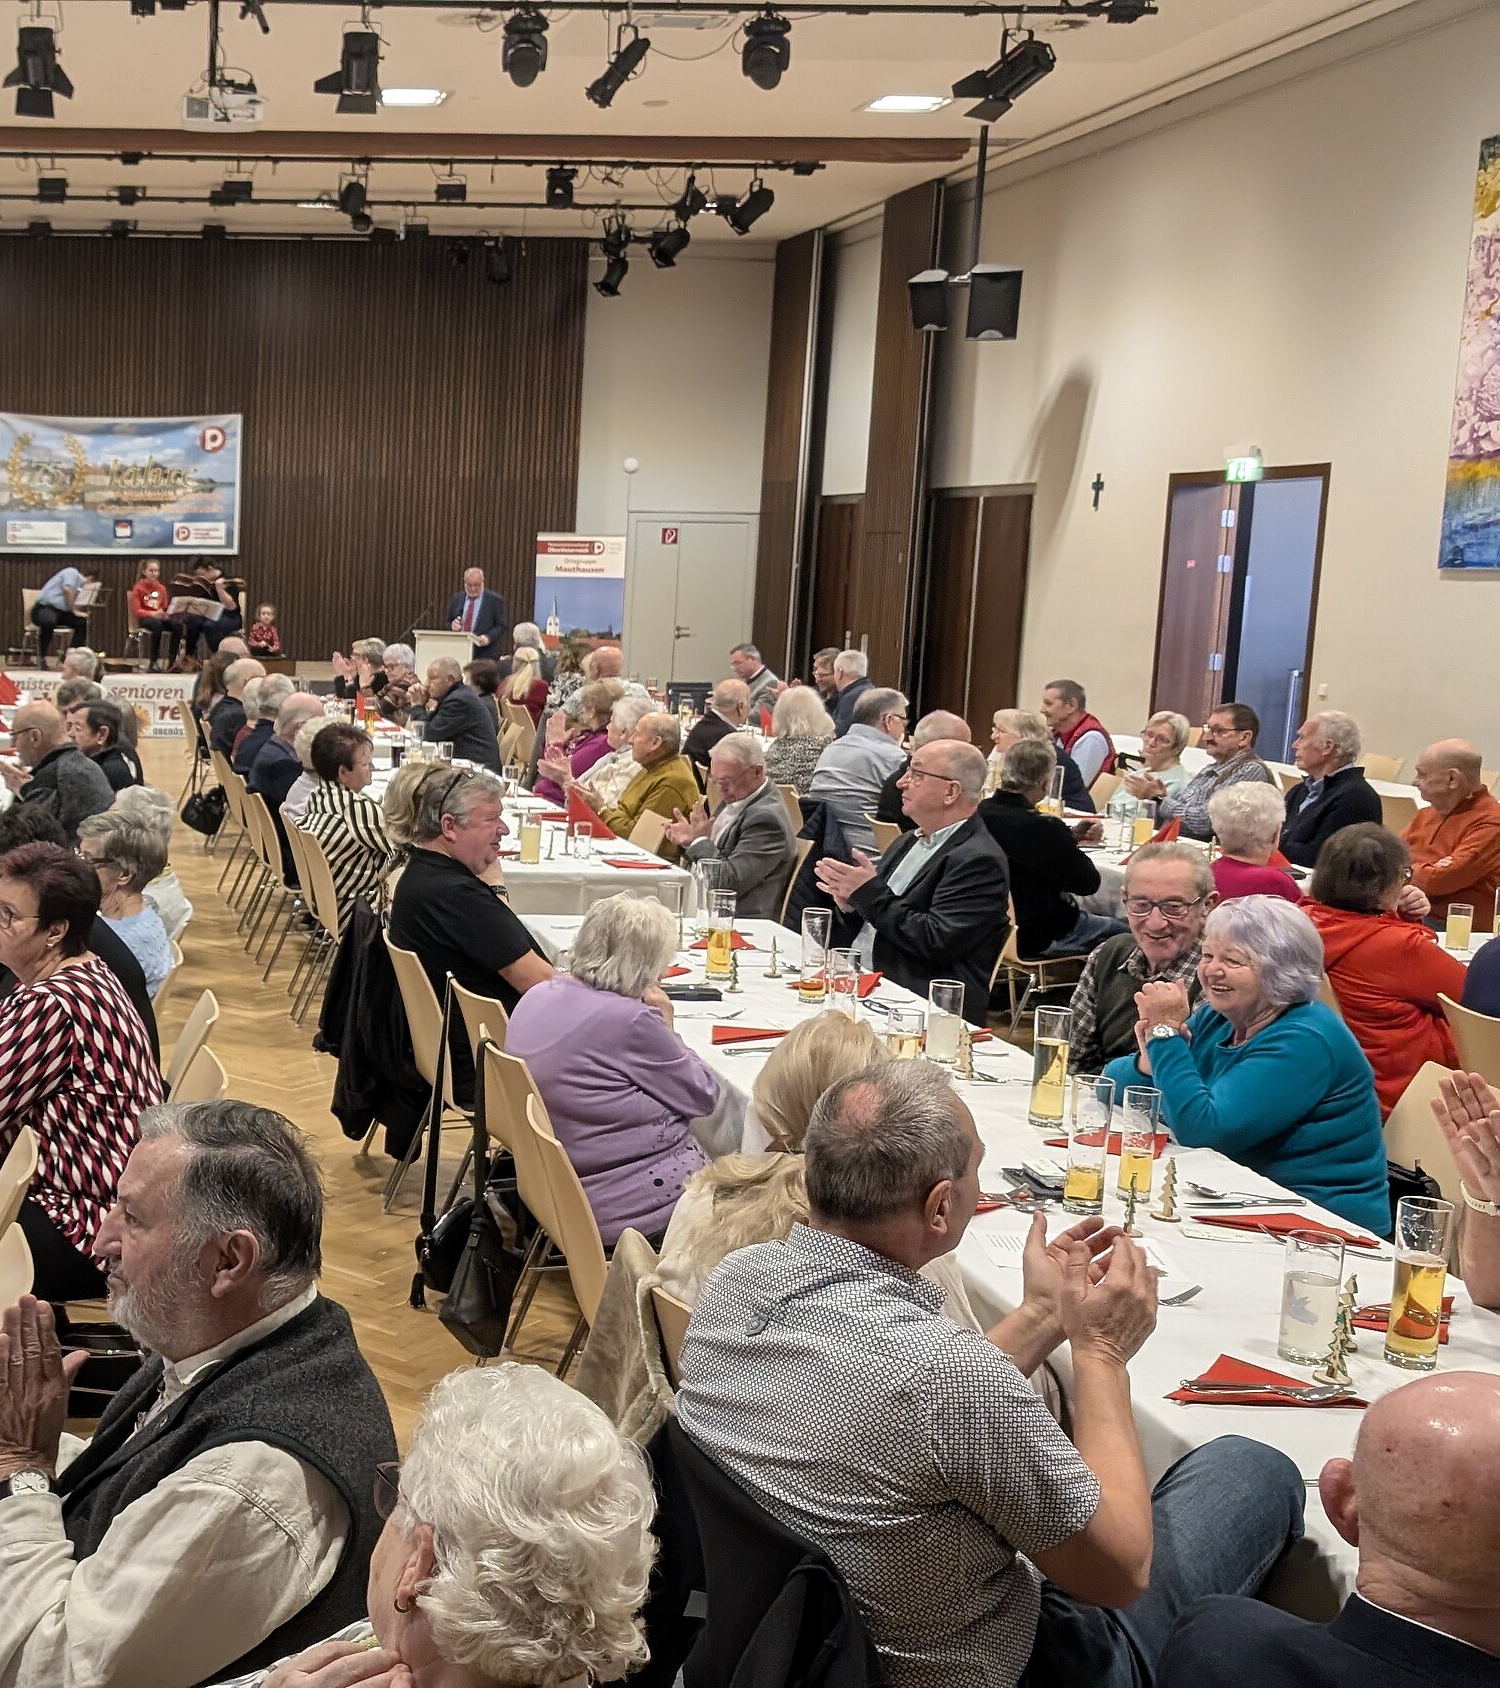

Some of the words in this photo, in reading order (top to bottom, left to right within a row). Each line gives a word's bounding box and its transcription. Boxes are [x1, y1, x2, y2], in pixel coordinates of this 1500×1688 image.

[107, 455, 199, 488] Jahre
[555, 565, 604, 573] Mauthausen
[107, 684, 184, 699] senioren
